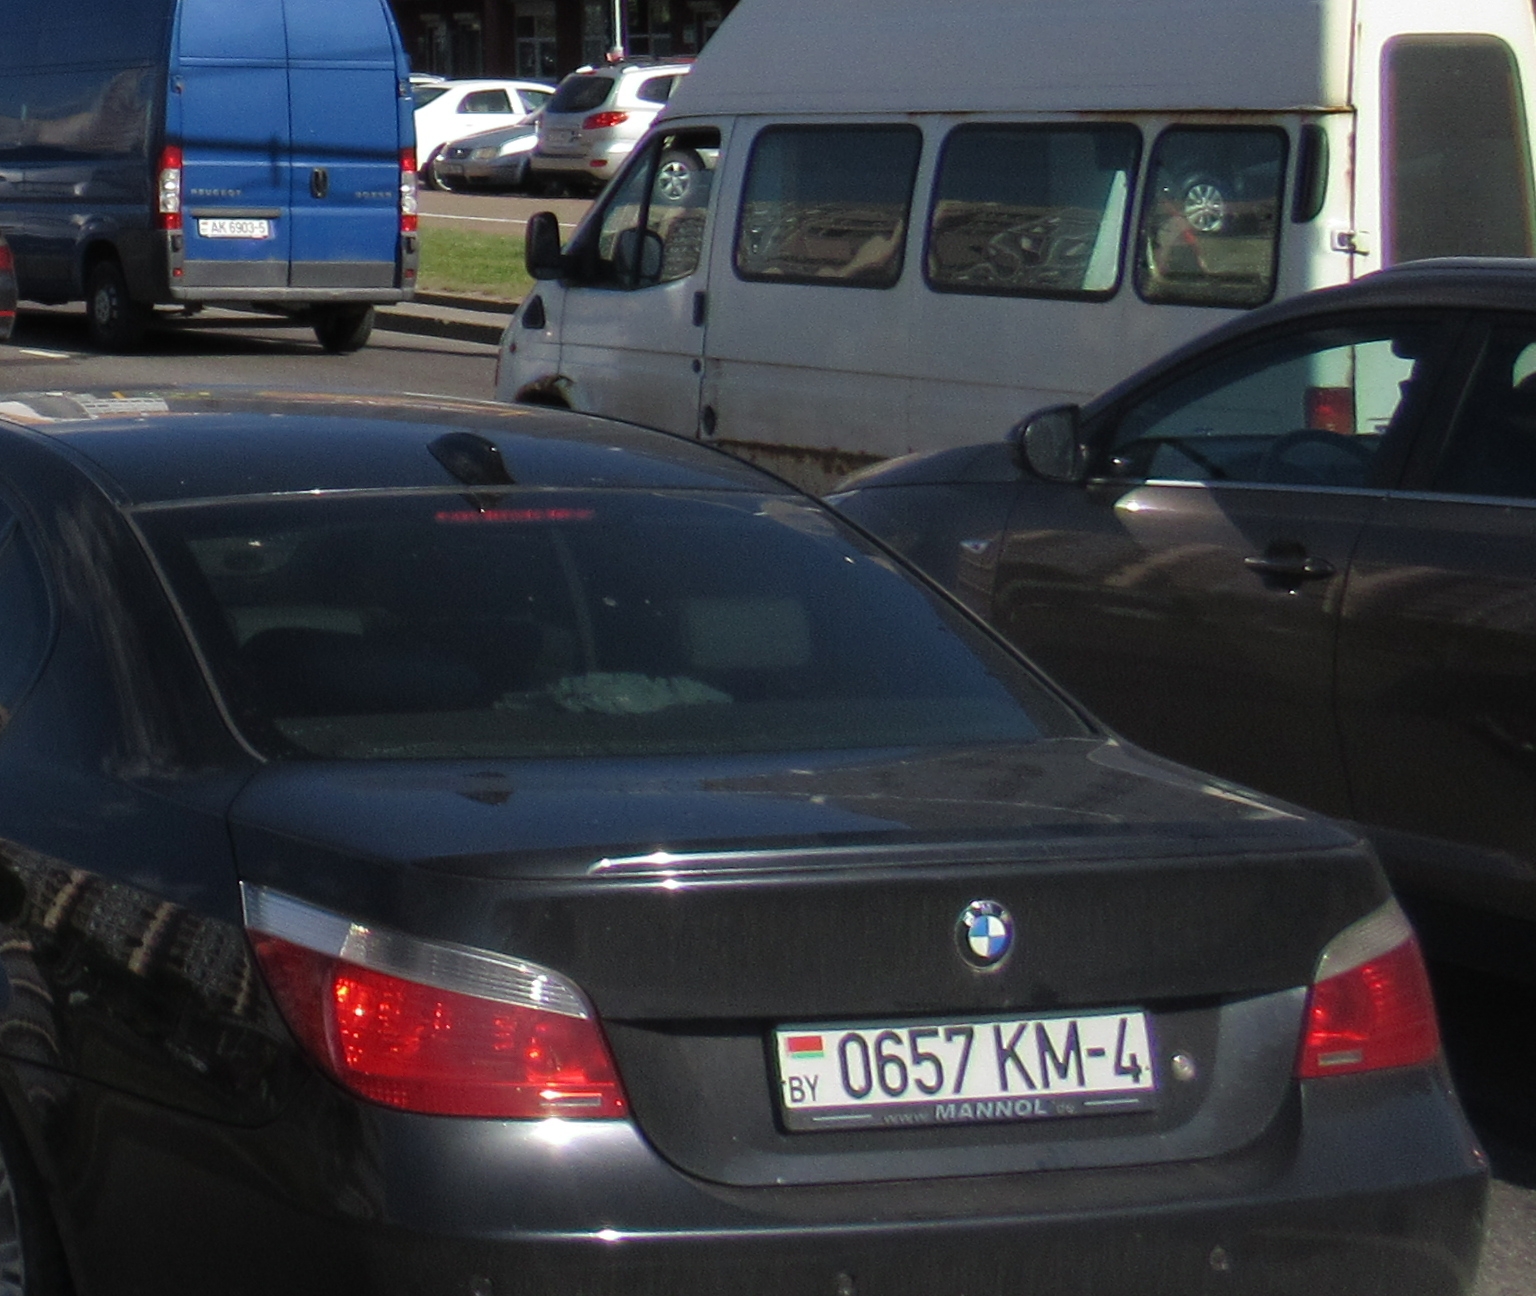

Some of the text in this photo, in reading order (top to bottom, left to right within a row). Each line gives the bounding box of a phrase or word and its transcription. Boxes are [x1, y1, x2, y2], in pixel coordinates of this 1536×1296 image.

[211, 221, 266, 234] AK 6903-5
[836, 1017, 1143, 1100] 0657 KM-4
[789, 1074, 820, 1104] BY
[934, 1097, 1048, 1121] MANNOL
